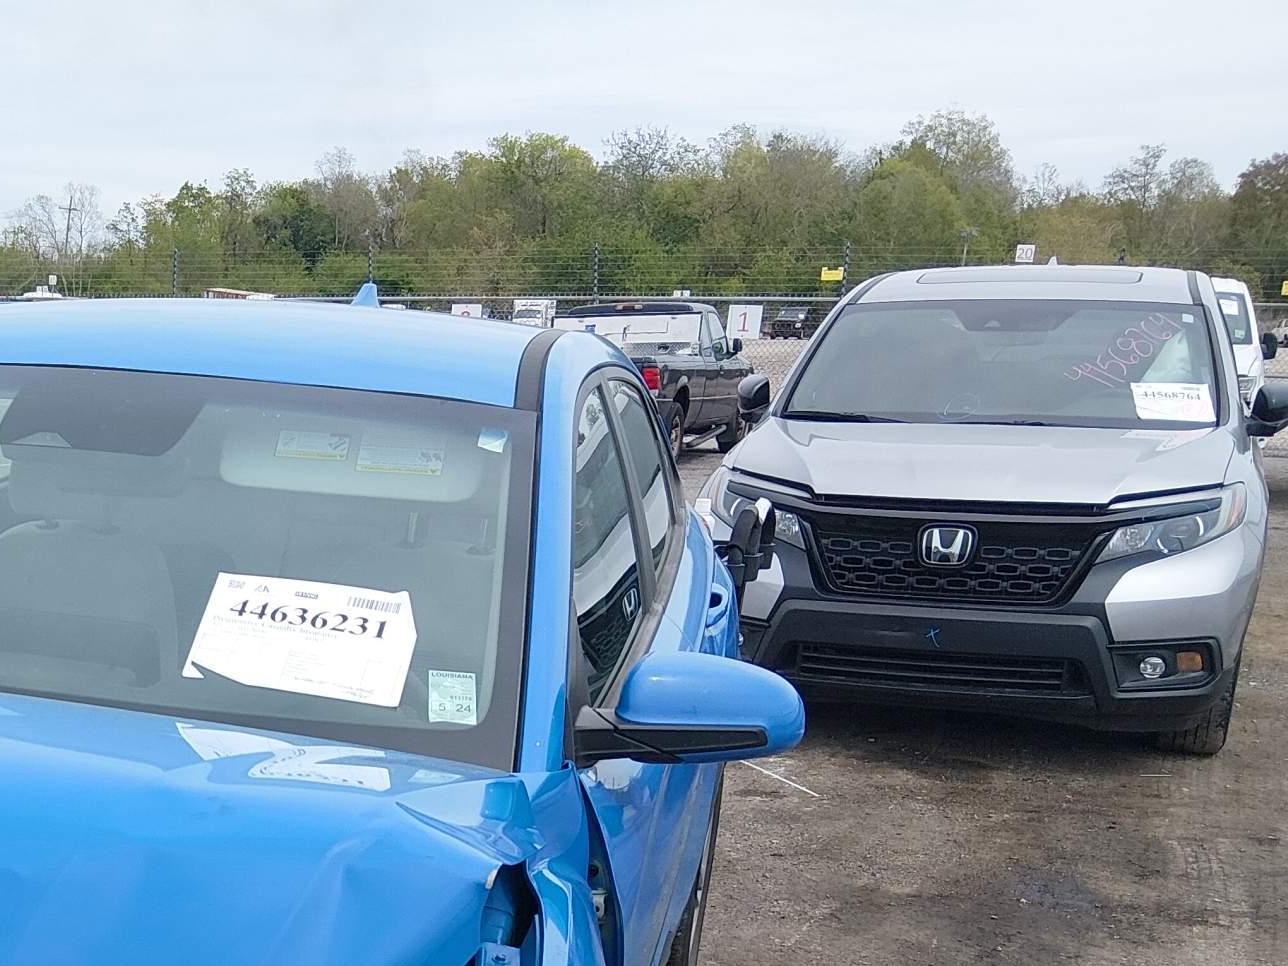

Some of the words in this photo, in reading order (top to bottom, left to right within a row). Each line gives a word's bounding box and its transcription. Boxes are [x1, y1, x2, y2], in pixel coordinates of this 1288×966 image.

[1016, 247, 1034, 261] 20
[736, 311, 749, 332] 1
[1141, 390, 1202, 401] 44568764
[229, 599, 388, 640] 44636231
[455, 703, 472, 713] 24
